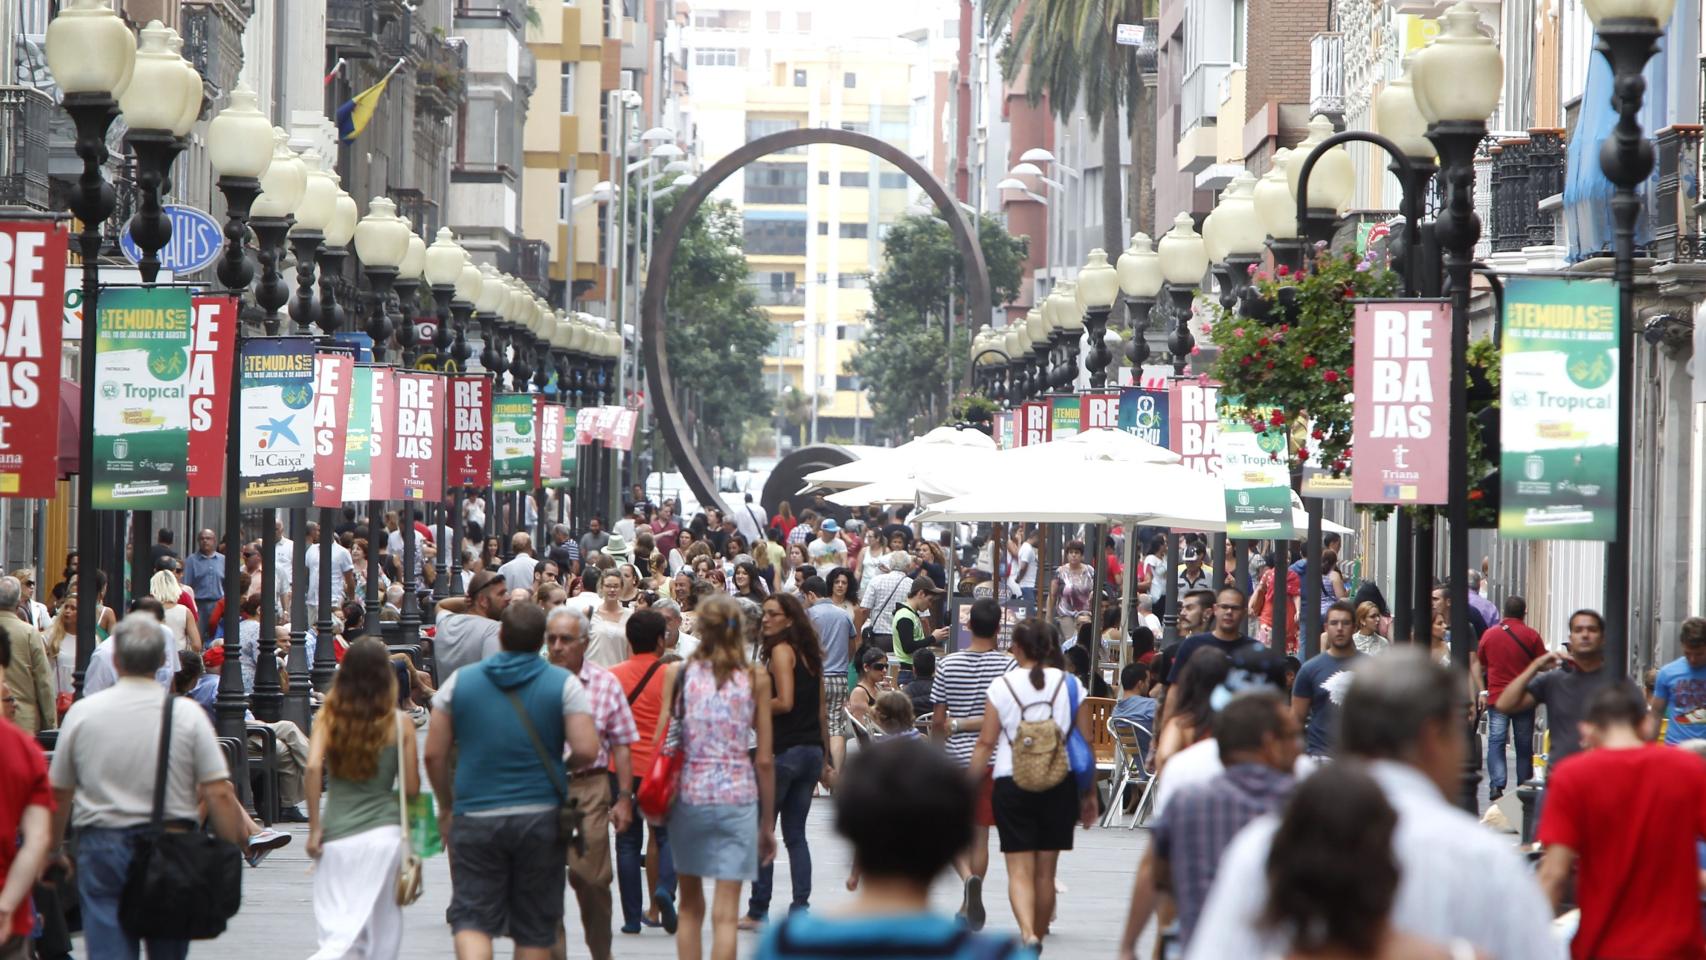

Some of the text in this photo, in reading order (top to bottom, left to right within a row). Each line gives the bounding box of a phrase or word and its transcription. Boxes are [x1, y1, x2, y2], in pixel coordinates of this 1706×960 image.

[0, 300, 42, 357] A
[107, 309, 175, 330] TEMUDAS
[190, 304, 220, 351] E
[1515, 303, 1599, 329] TEMUDAS
[1374, 310, 1433, 358] RE
[189, 353, 215, 395] A
[249, 354, 303, 371] TEMUDAS
[123, 383, 185, 402] Tropical
[371, 372, 383, 403] E
[400, 378, 433, 408] RE
[454, 381, 482, 407] RE
[1372, 360, 1433, 402] BA
[314, 396, 336, 428] A
[1090, 399, 1119, 427] RE
[1537, 391, 1611, 412] Tropical
[398, 409, 433, 437] BA
[454, 407, 483, 431] BA
[1370, 405, 1431, 439] JAS
[396, 437, 432, 459] JAS
[454, 432, 483, 451] JAS
[1383, 470, 1419, 479] Triana
